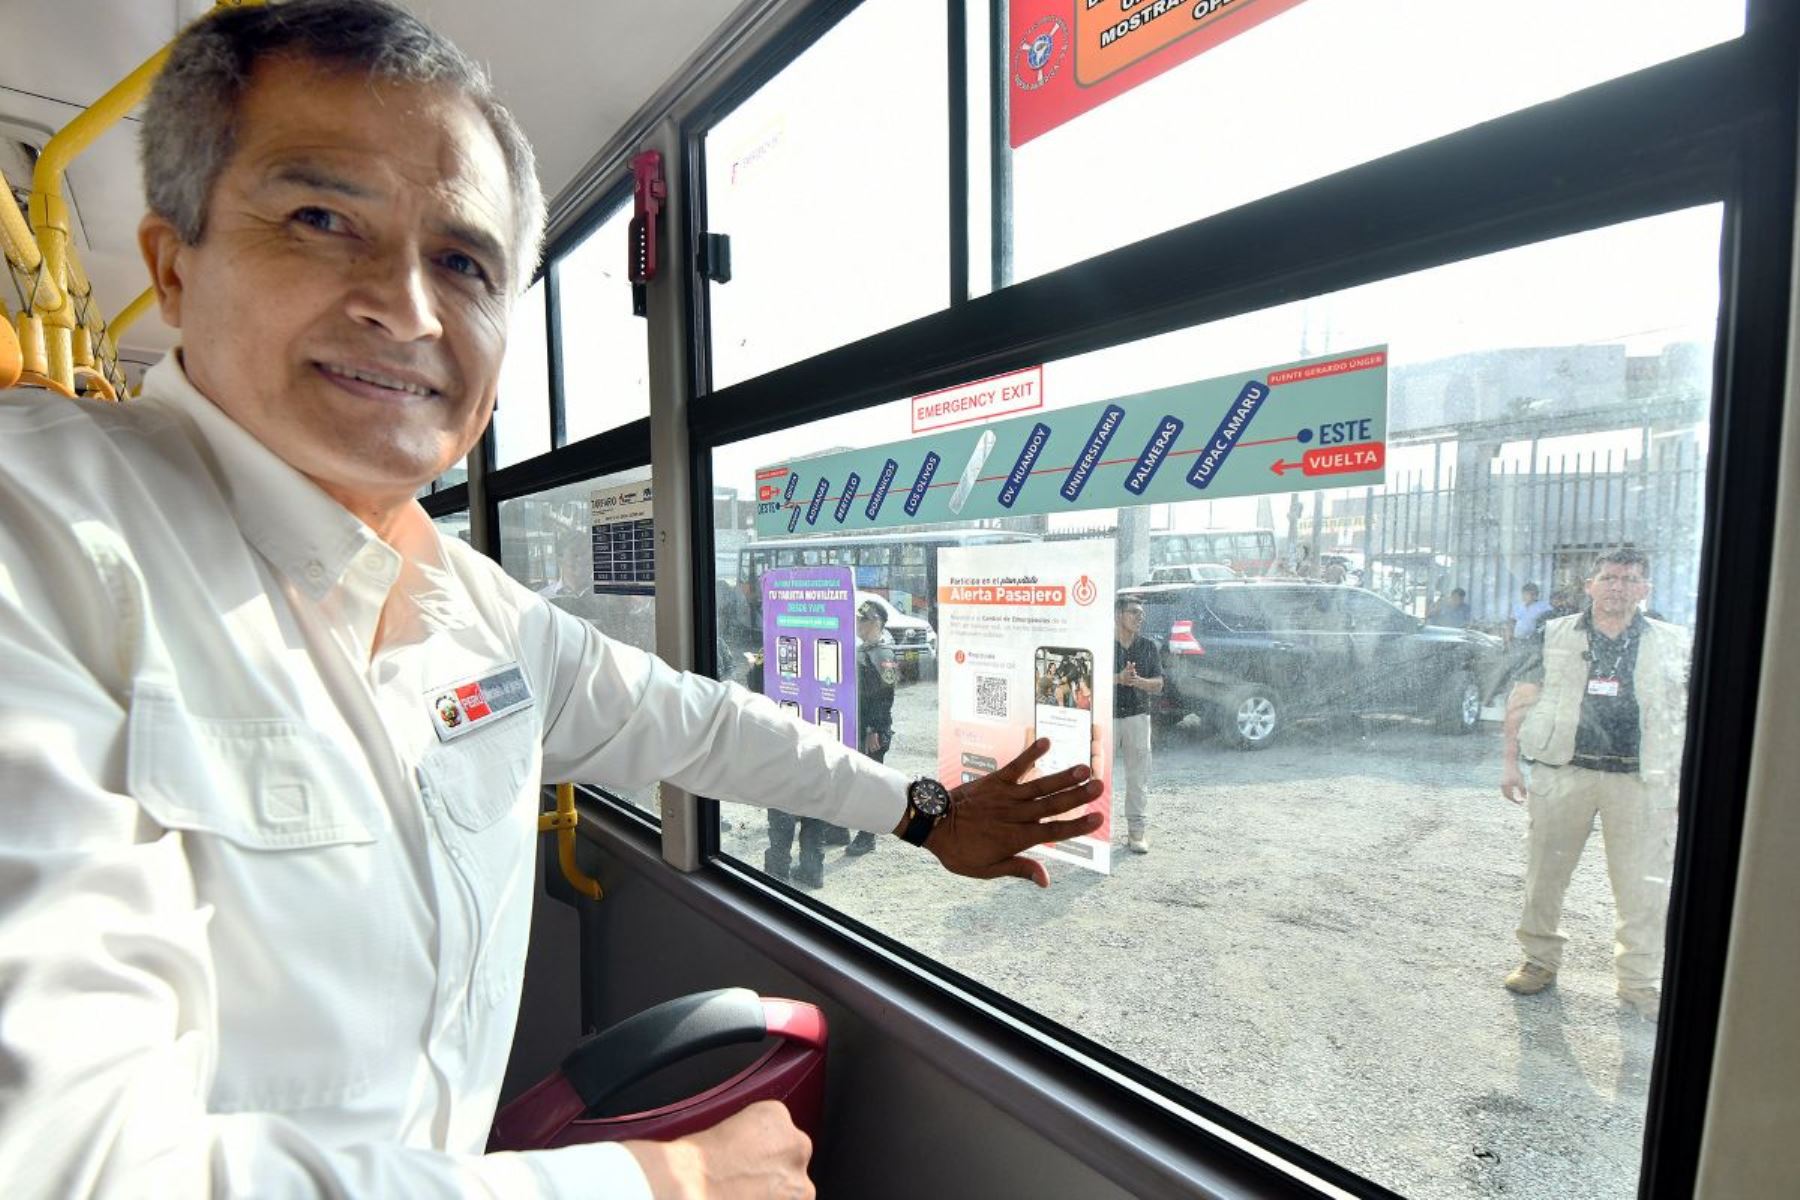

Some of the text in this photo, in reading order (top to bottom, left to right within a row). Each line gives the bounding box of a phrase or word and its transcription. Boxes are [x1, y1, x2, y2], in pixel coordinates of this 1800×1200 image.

[1100, 0, 1188, 48] MOSTRA
[1270, 371, 1301, 384] PUENTE
[1303, 362, 1348, 379] GERARDO
[916, 380, 1034, 421] EMERGENCY EXIT
[1013, 426, 1045, 485] HUANDOY
[1065, 410, 1120, 497] UNIVERSITARIA
[1130, 421, 1177, 489] PALMERAS
[1193, 387, 1262, 484] TUPAC AMARU
[1318, 418, 1372, 445] ESTE
[907, 455, 938, 512] LOS OLIVOS
[1308, 449, 1378, 469] VUELTA
[868, 463, 895, 517] DOMINICOS
[950, 587, 1062, 603] Alerta Pasajero
